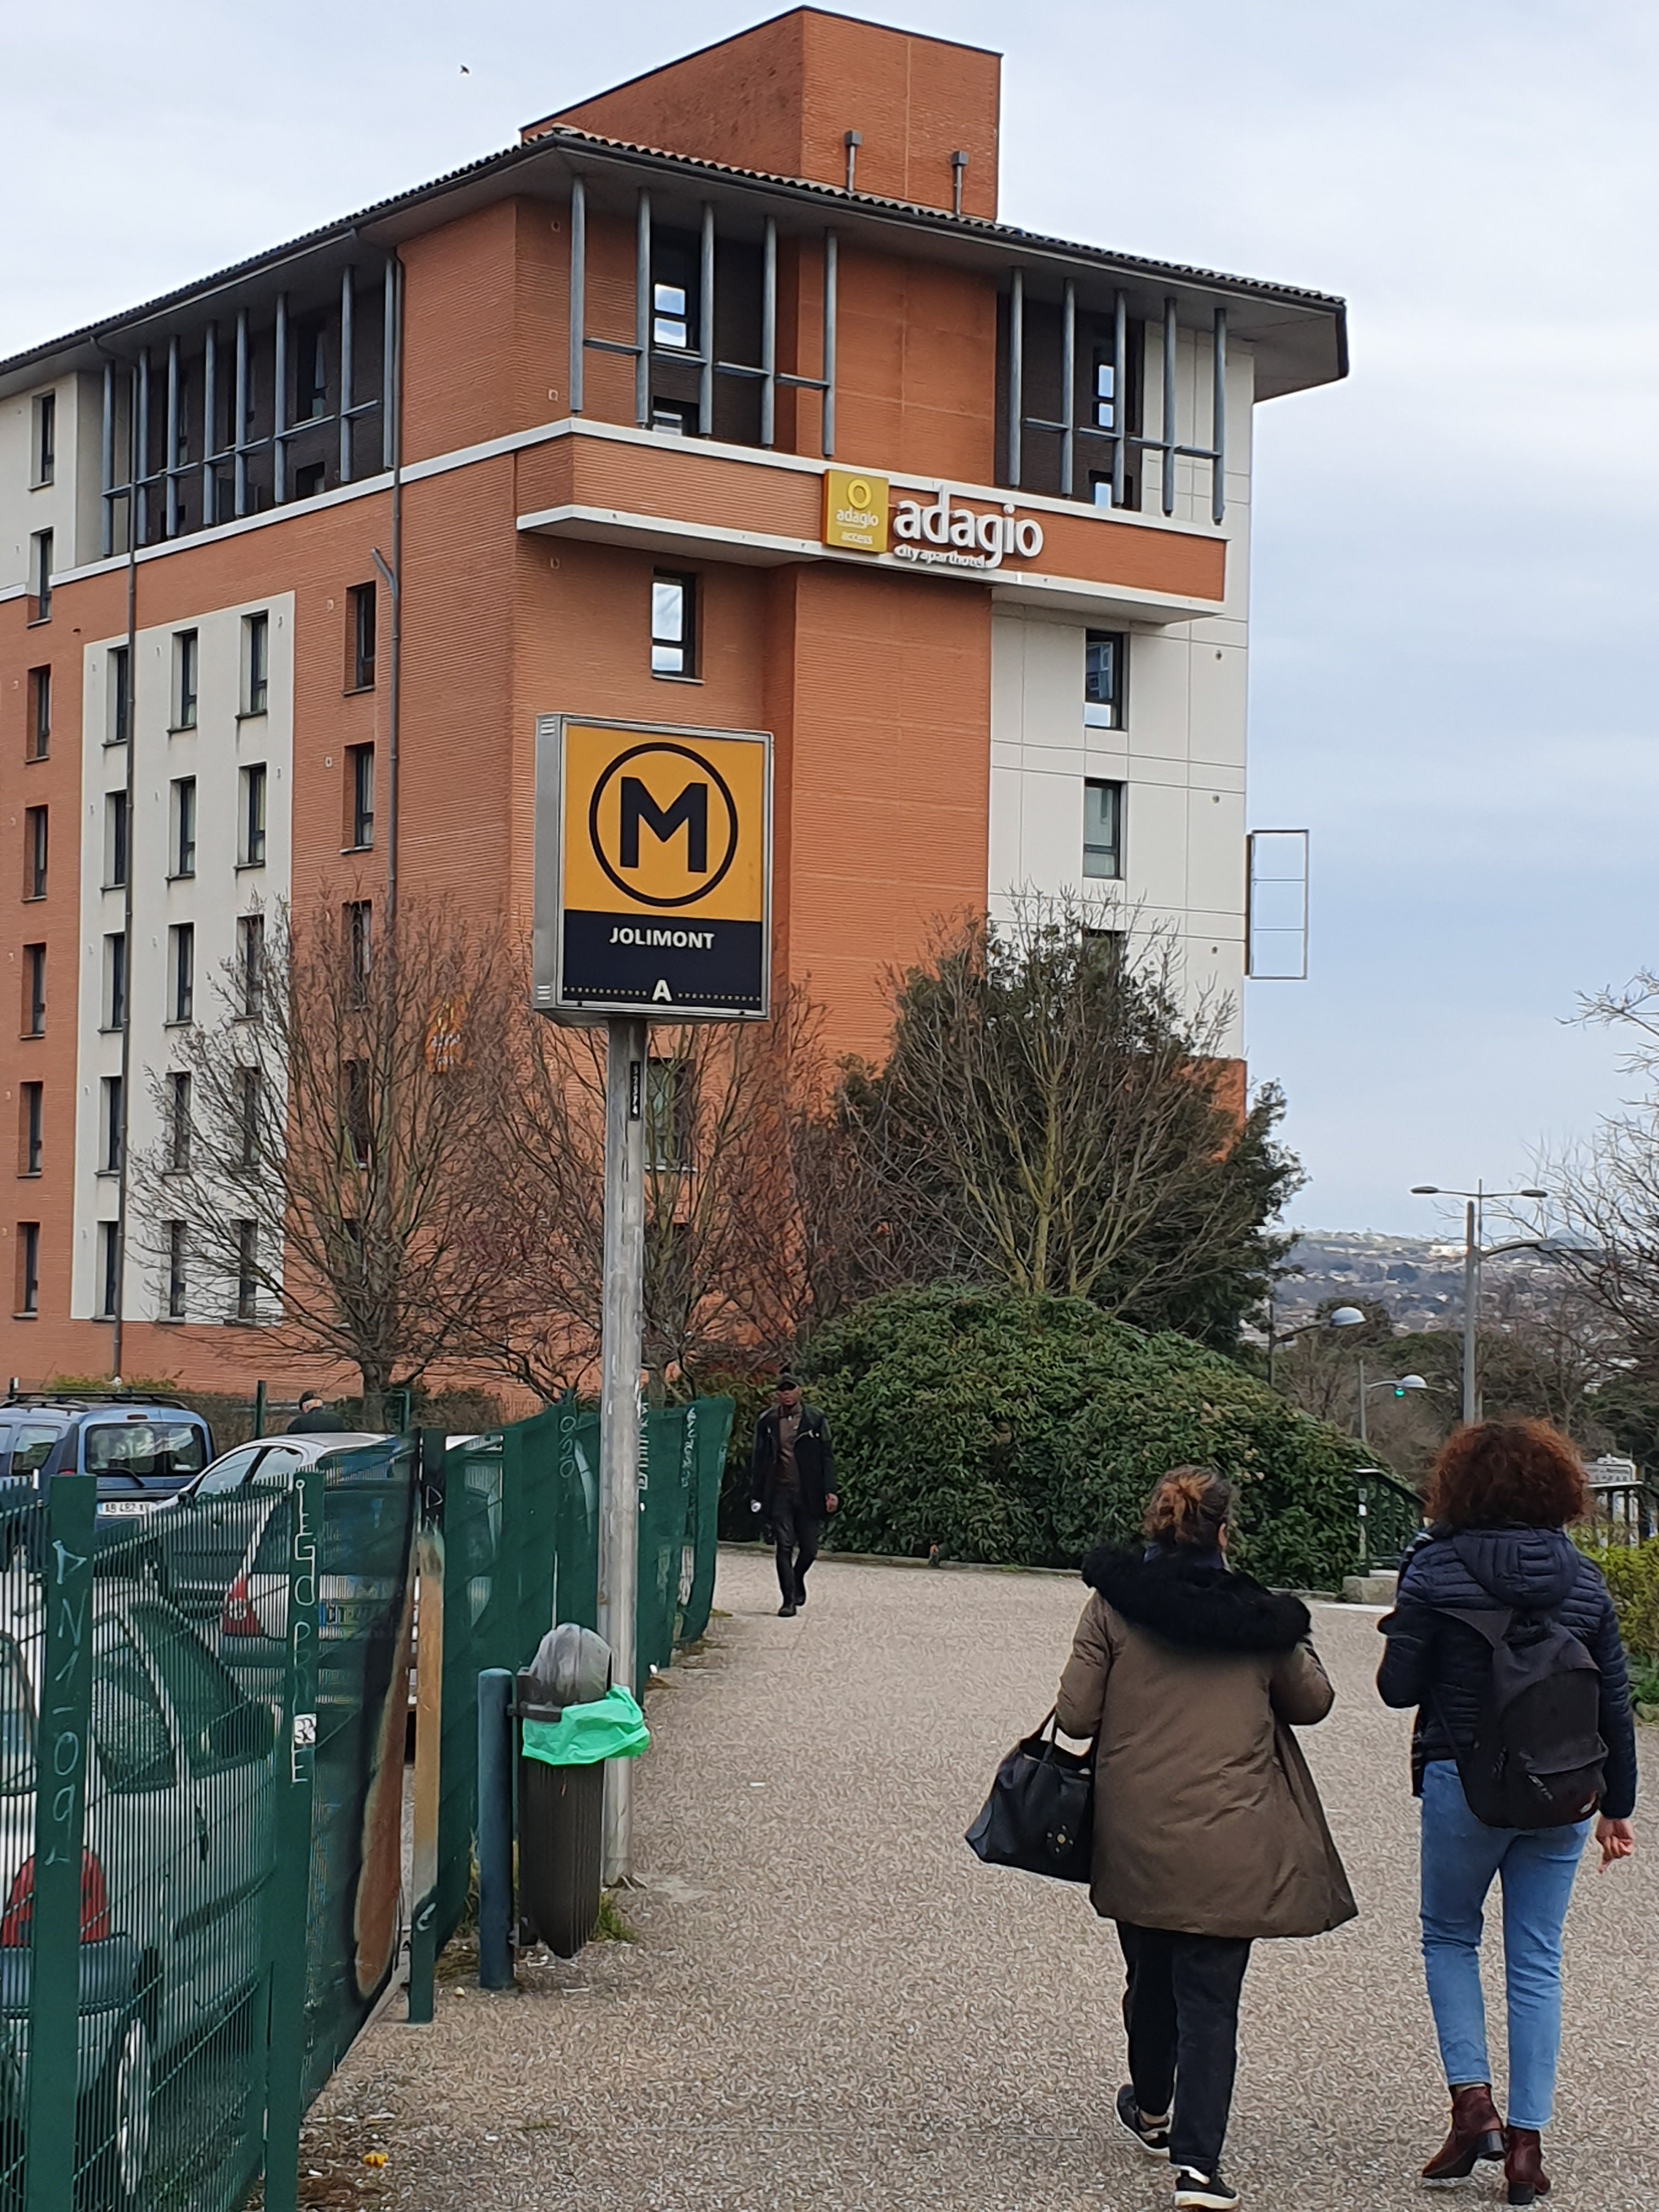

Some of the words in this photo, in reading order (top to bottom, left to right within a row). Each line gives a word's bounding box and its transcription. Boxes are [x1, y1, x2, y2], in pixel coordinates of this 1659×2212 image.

[836, 505, 879, 529] adagio
[894, 482, 1043, 568] adagio
[619, 776, 708, 873] M
[609, 927, 715, 950] JOLIMONT
[652, 979, 673, 1002] A
